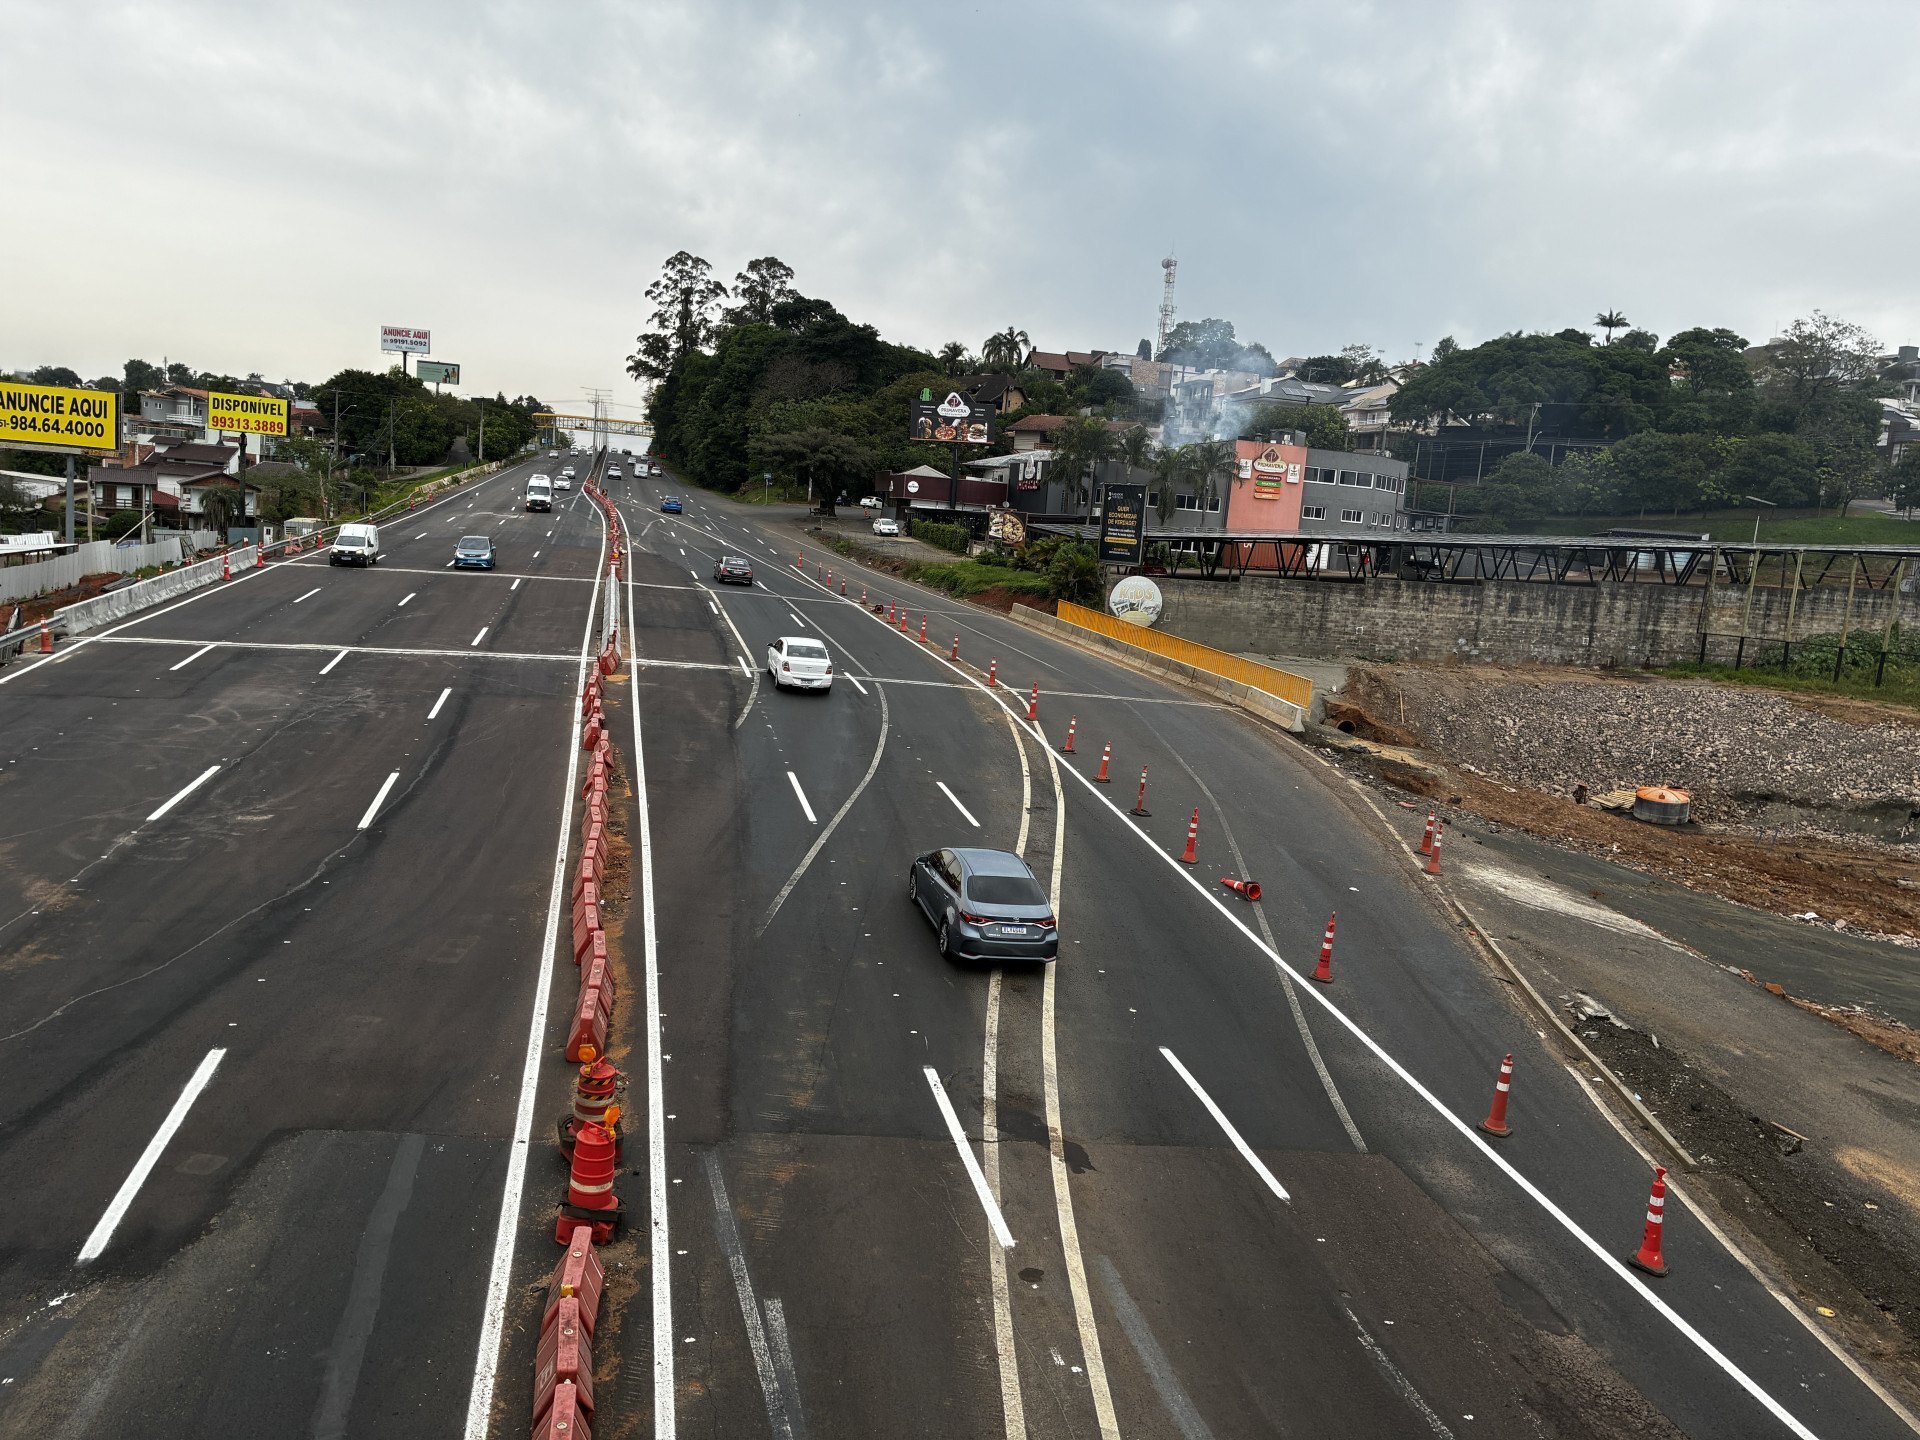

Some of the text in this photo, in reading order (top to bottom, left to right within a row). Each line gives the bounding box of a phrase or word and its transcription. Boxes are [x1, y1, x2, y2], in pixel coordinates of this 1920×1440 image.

[383, 328, 428, 340] ANUNCIE AQUI
[389, 338, 427, 347] 99191.5092
[69, 397, 108, 419] AQUI
[212, 397, 284, 416] DISPONÍVEL
[211, 415, 284, 433] 99313.3889
